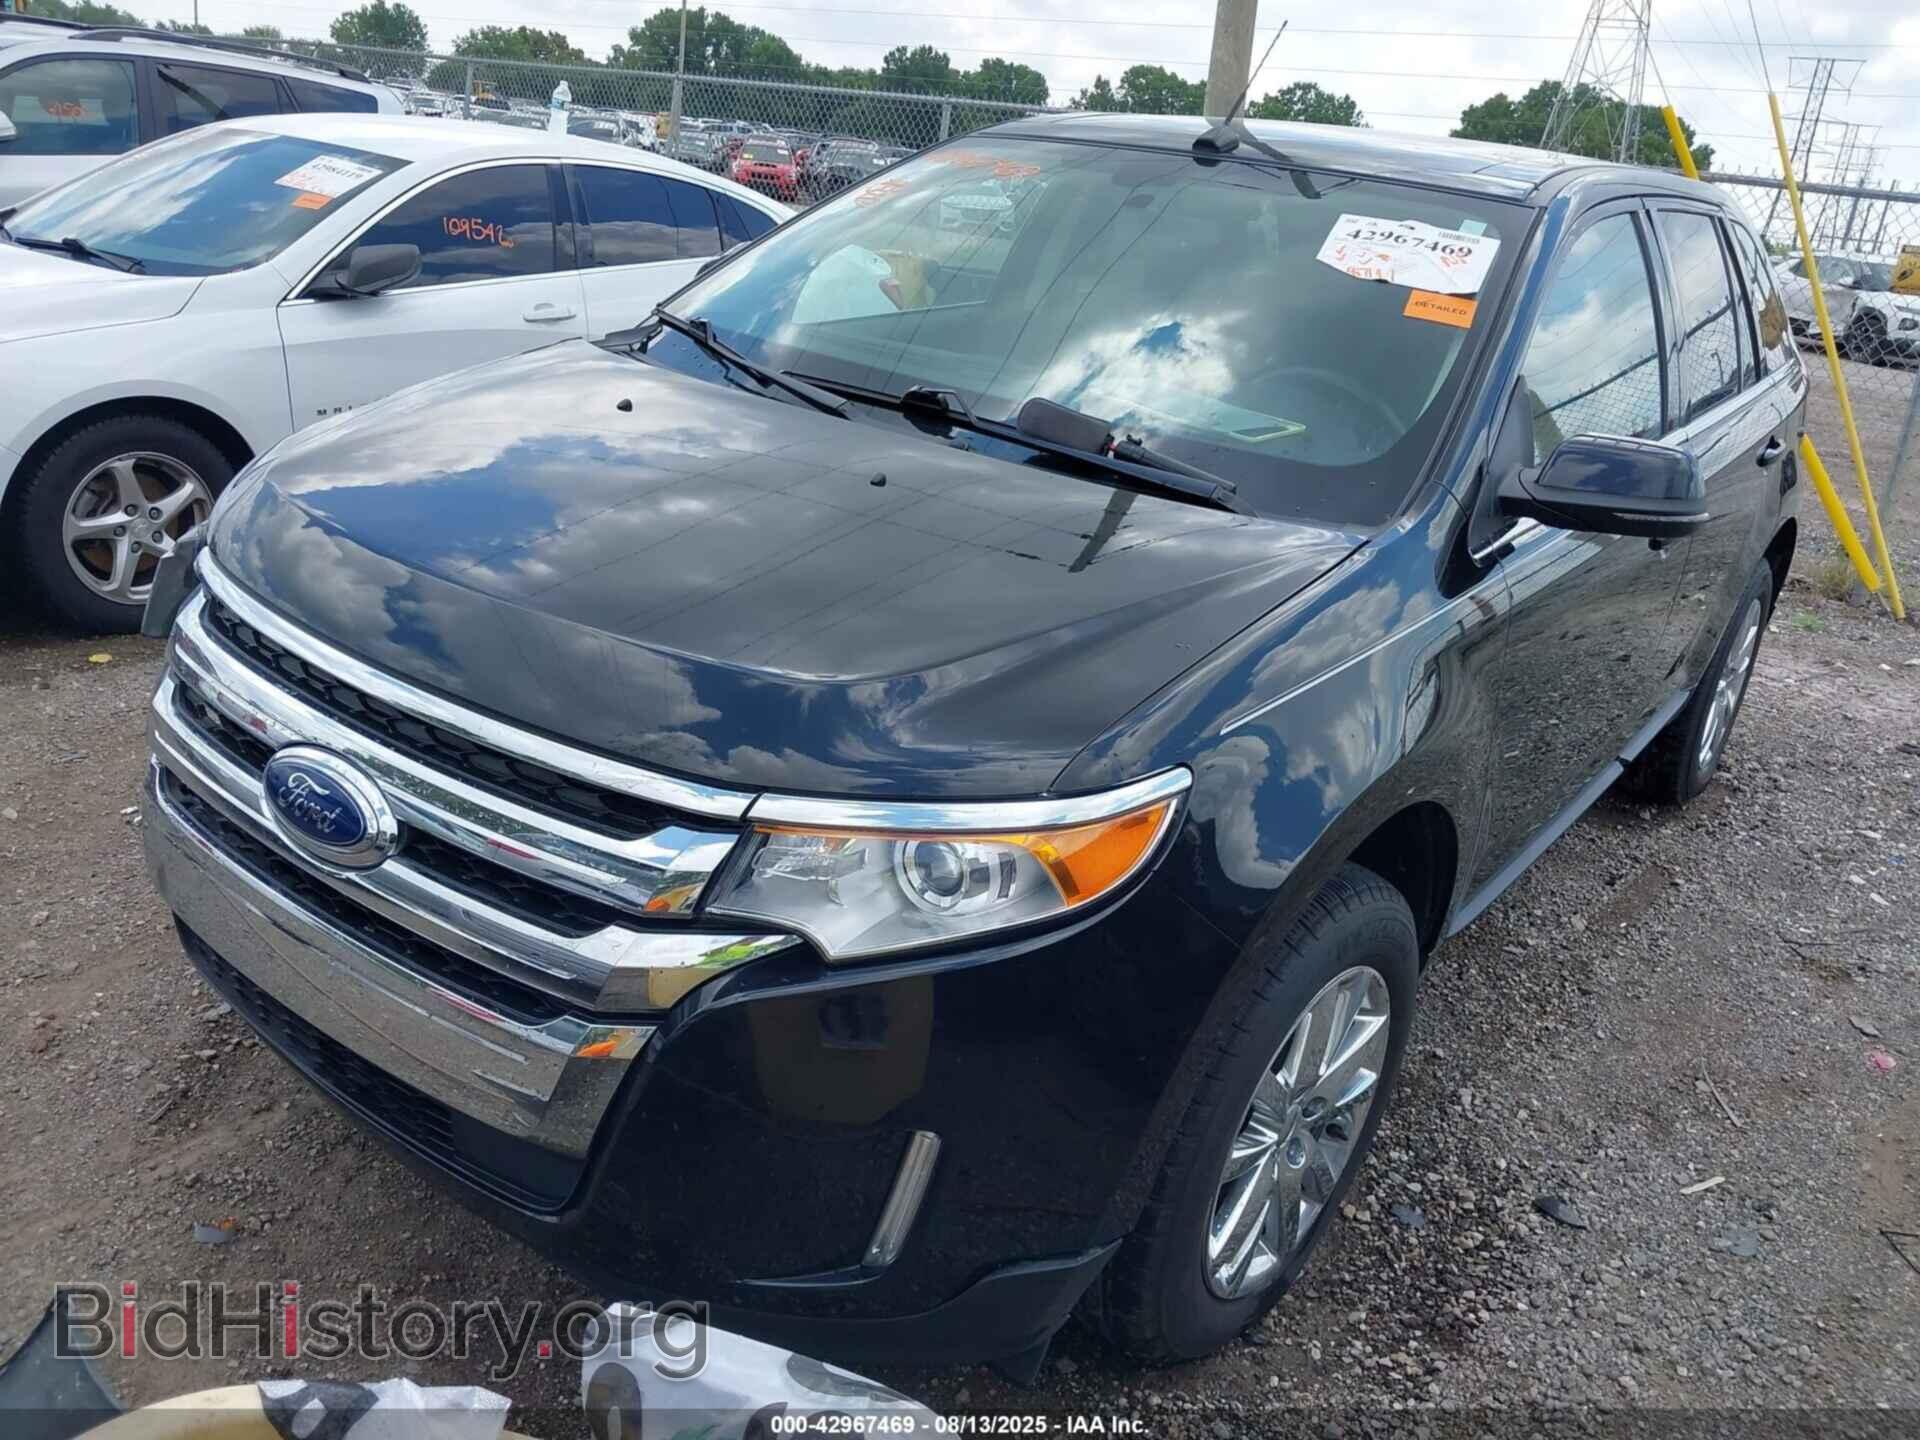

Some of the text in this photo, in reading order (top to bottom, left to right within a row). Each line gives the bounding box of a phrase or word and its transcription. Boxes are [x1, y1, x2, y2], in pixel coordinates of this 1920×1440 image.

[1345, 228, 1473, 258] 42967469
[1414, 300, 1467, 317] DETAILED
[278, 772, 343, 833] Ford
